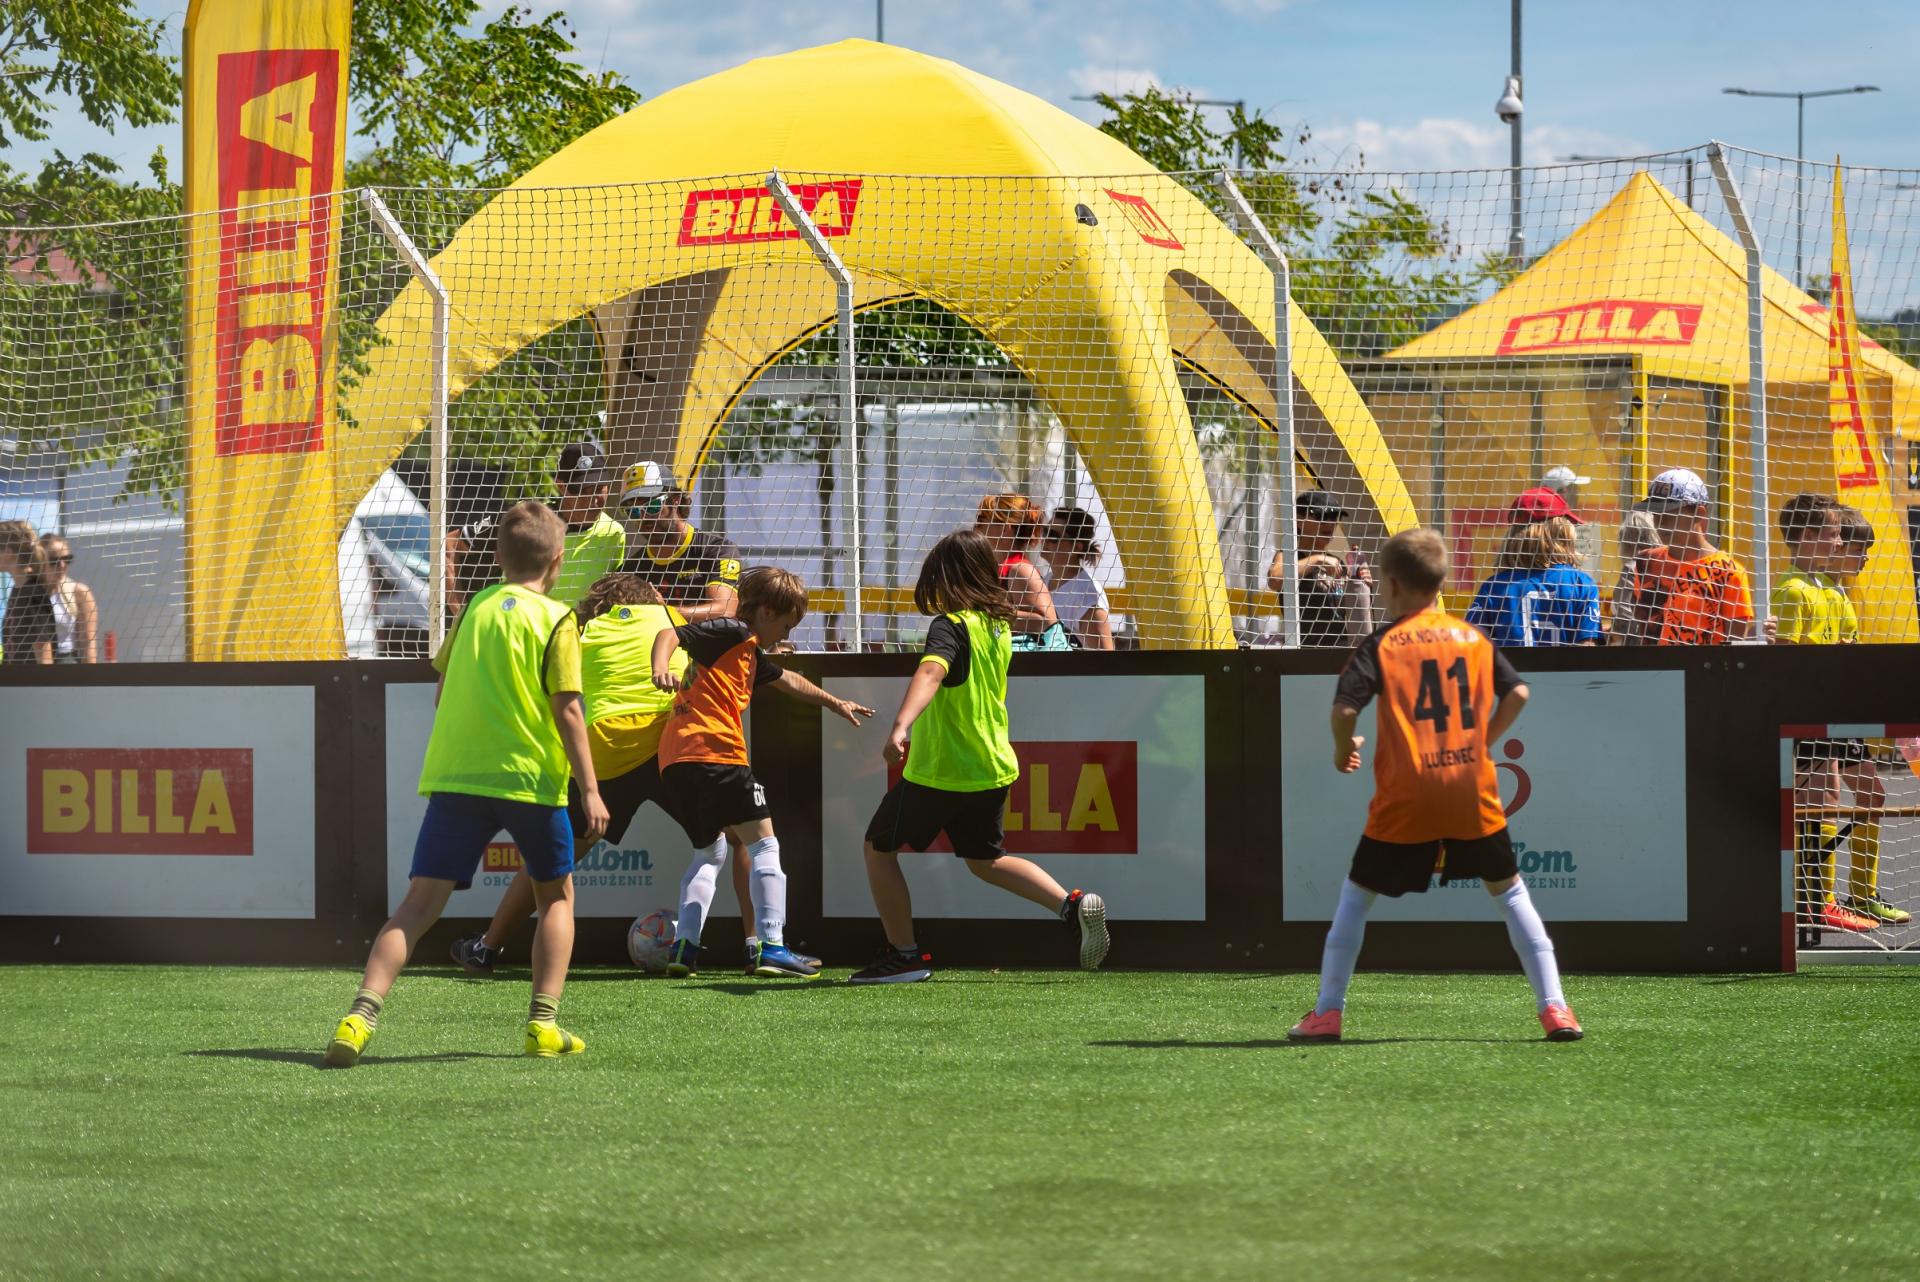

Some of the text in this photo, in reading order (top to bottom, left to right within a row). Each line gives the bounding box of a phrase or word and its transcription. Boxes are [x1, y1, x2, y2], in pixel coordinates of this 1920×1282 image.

[237, 71, 317, 425] BILLA
[1510, 306, 1683, 349] BILLA
[1414, 656, 1475, 733] 41
[42, 769, 237, 834] BILLA
